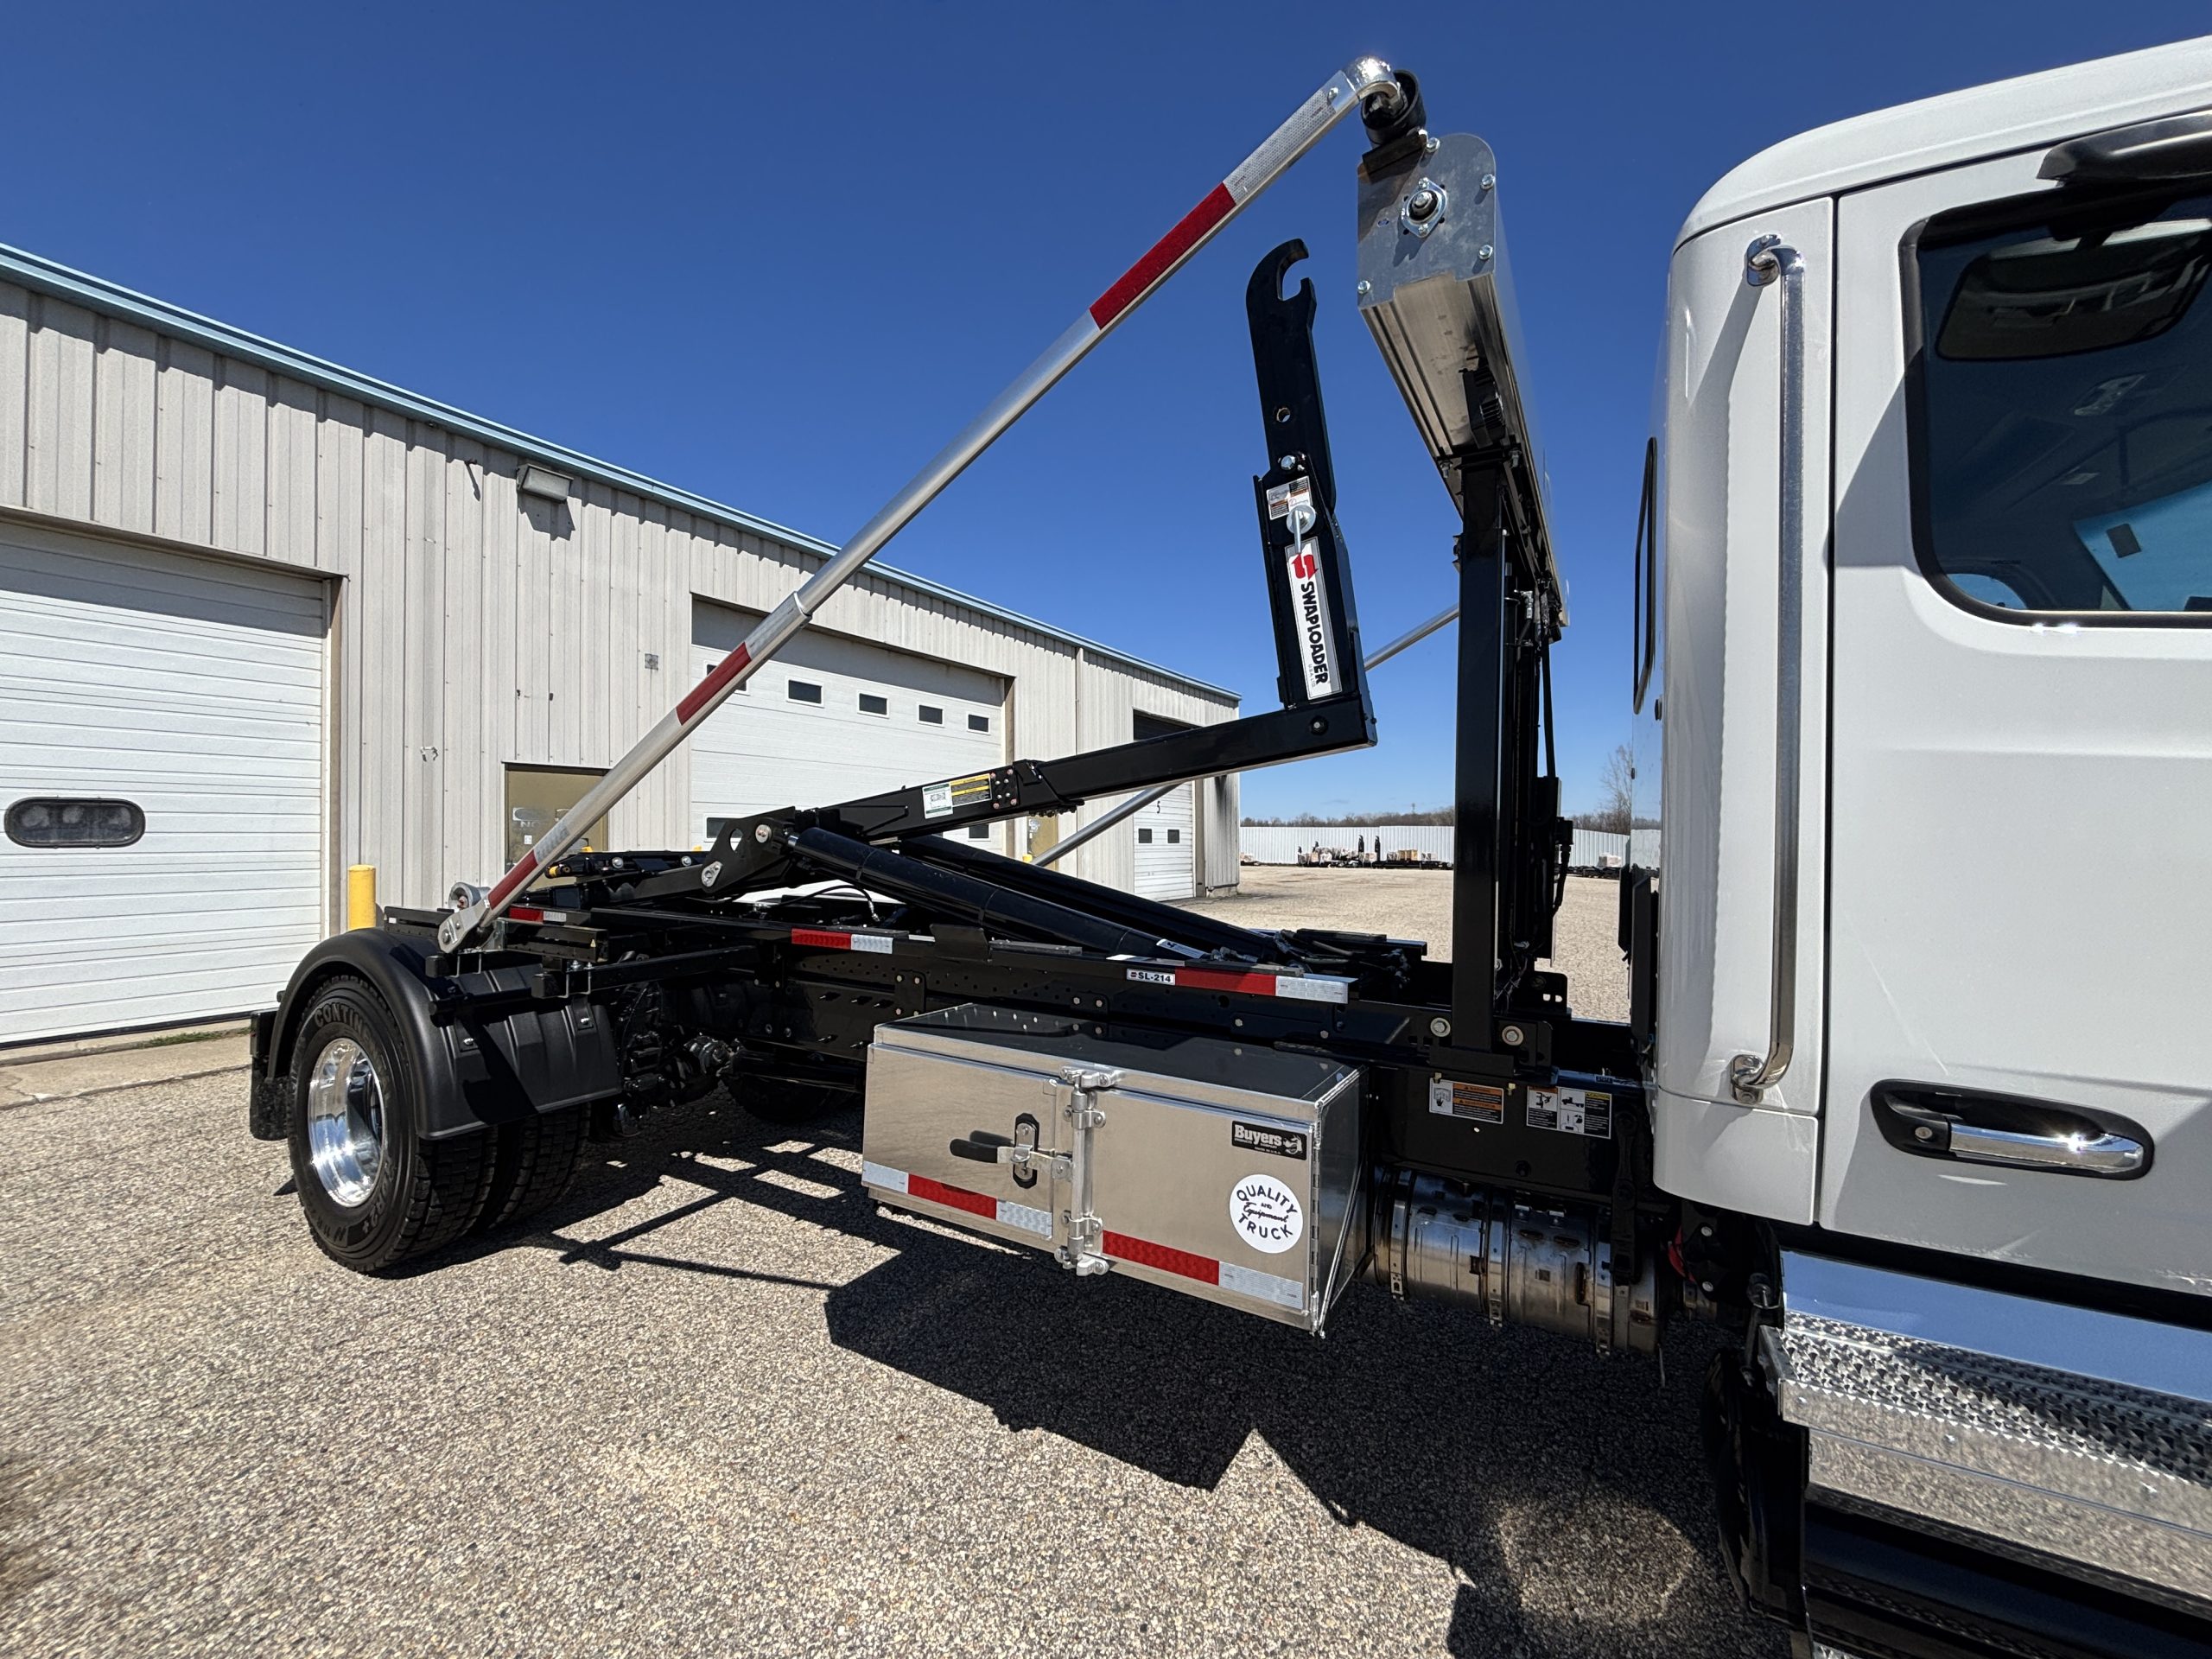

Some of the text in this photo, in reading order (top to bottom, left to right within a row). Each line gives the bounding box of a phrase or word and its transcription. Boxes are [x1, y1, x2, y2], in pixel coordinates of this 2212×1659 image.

[1300, 581, 1329, 685] SWAPLOADER
[1138, 971, 1172, 983] SL-214
[1235, 1124, 1282, 1146] Buyers
[1236, 1185, 1298, 1214] QUALITY
[1243, 1202, 1289, 1223] Equipment
[1238, 1212, 1294, 1240] TRUCK
